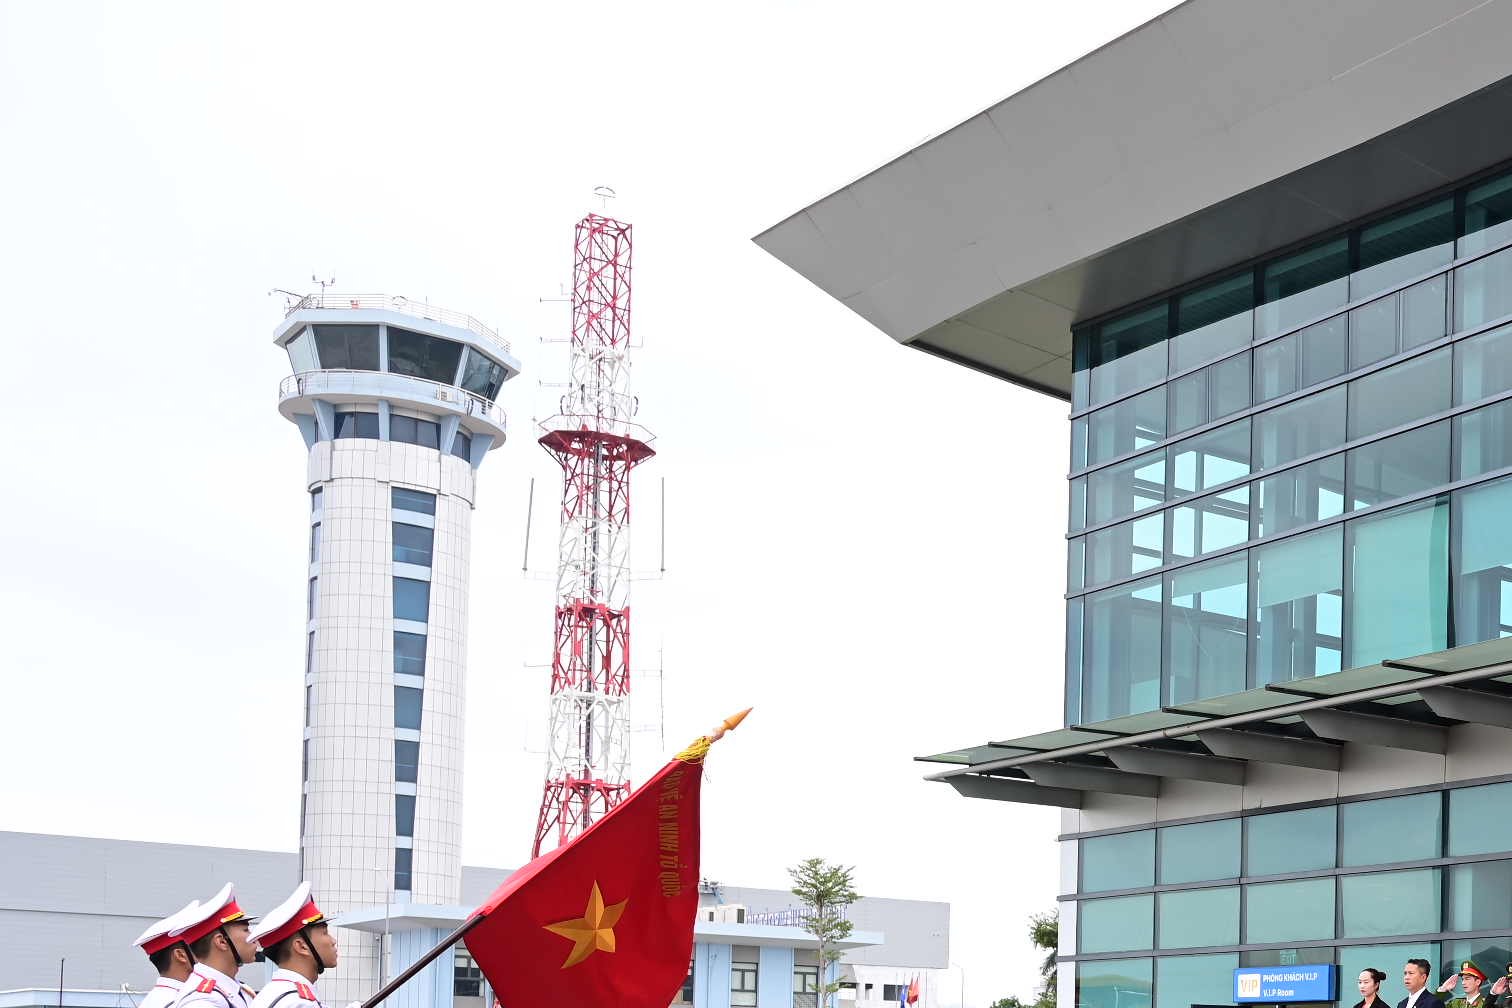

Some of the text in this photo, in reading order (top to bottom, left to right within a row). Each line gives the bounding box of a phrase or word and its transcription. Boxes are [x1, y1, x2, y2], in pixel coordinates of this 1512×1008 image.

[1262, 973, 1283, 983] PHÒNG
[1284, 972, 1304, 982] KHÁCH
[1240, 979, 1258, 992] VIP
[1278, 988, 1294, 996] Room
